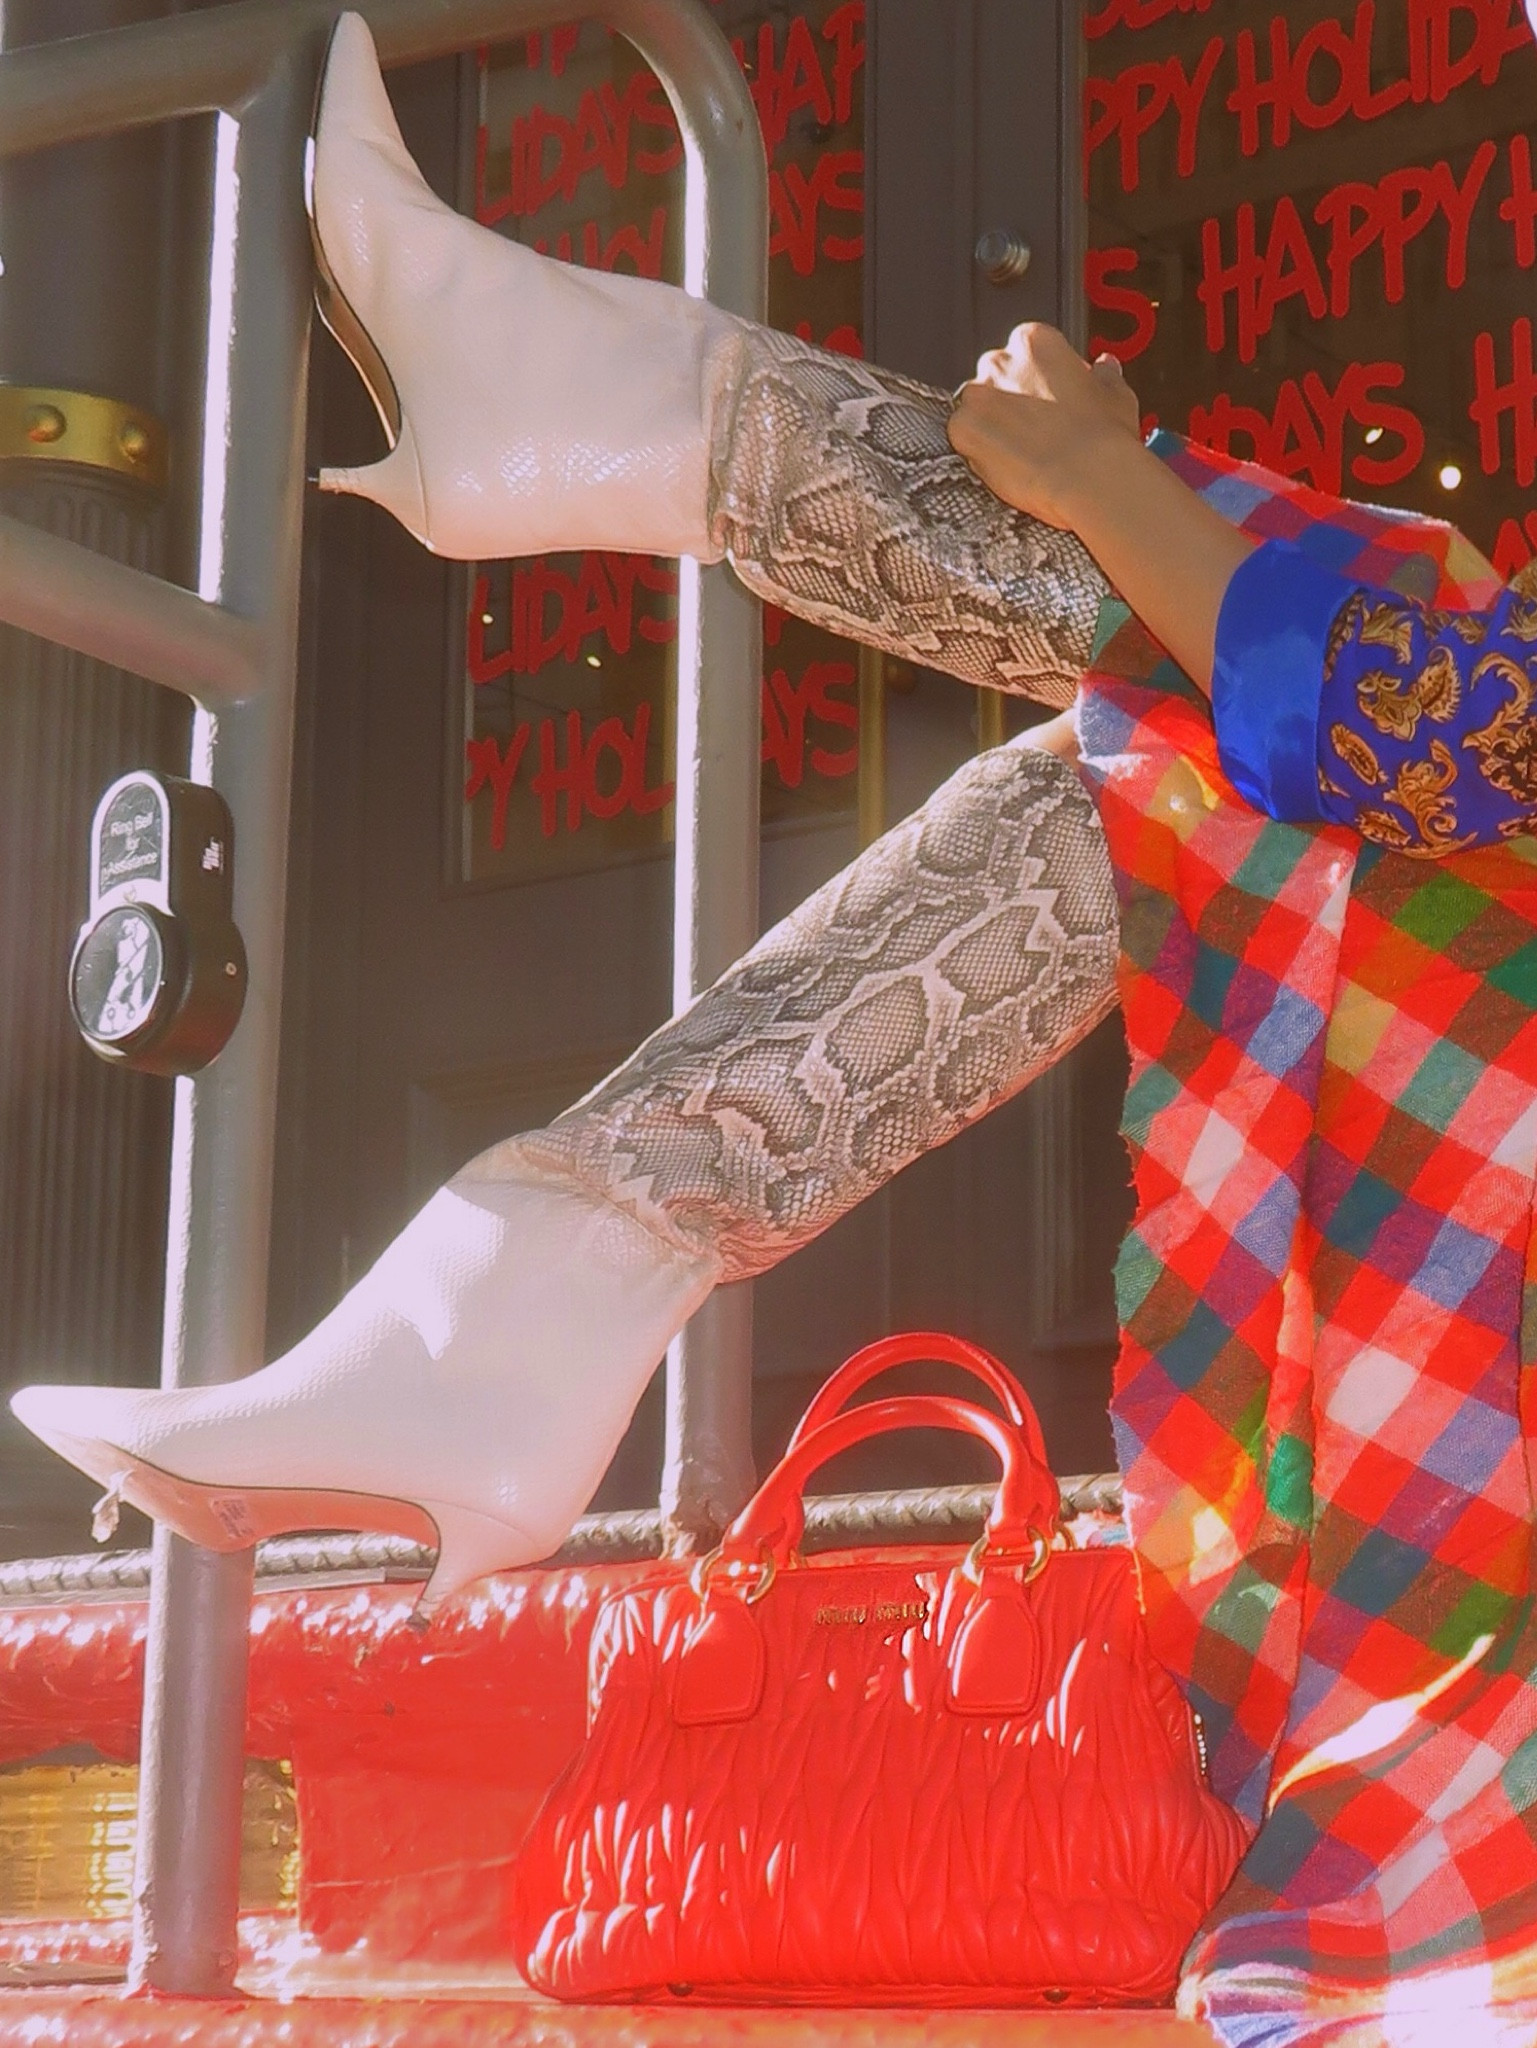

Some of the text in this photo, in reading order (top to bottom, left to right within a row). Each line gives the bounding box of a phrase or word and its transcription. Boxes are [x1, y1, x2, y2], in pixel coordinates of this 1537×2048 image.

[1198, 140, 1497, 364] HAPPY
[1140, 317, 1537, 497] DAYS H
[107, 852, 157, 874] Assistance
[111, 811, 154, 837] Ring Bell
